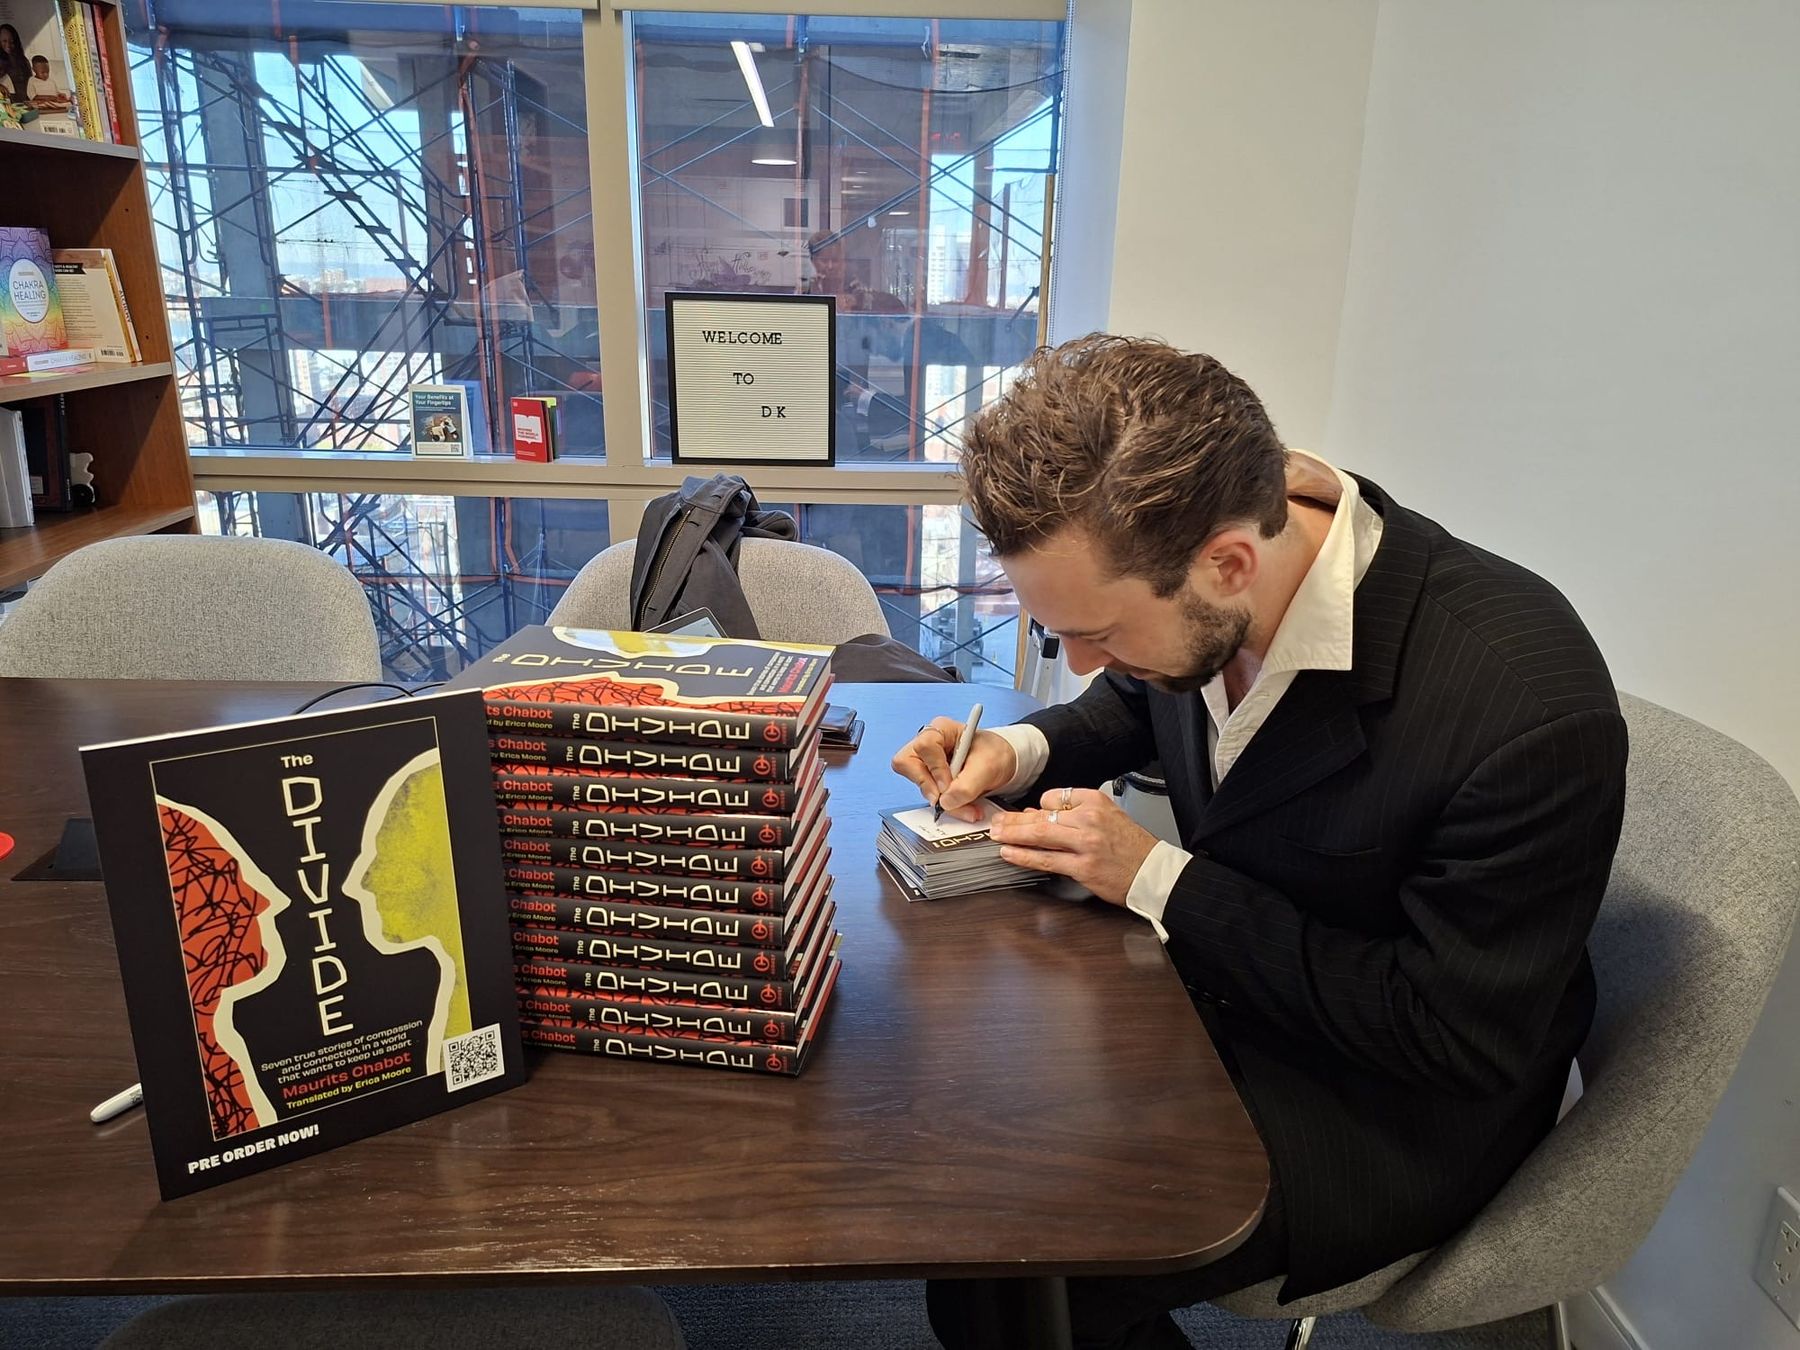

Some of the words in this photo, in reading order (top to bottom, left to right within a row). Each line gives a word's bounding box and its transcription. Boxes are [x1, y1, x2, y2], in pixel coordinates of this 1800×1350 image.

[13, 280, 44, 290] CHAKRA
[13, 290, 46, 301] HEALING
[702, 330, 783, 345] WELCOME
[732, 372, 754, 385] TO
[492, 652, 510, 664] The
[510, 654, 754, 678] DIVIDE
[503, 706, 553, 719] Chabot
[505, 720, 526, 728] Erica
[586, 712, 751, 740] DIVIDE
[498, 738, 547, 751] Chabot
[280, 752, 314, 770] The
[579, 745, 741, 772] DIVIDE
[503, 780, 553, 792] Chabot
[586, 784, 749, 807] DIVIDE
[504, 815, 552, 826] Chabot
[585, 819, 746, 842] DIVIDE
[504, 840, 551, 852] Chabot
[582, 846, 738, 873] DIVIDE
[509, 869, 555, 881] Chabot
[585, 875, 739, 904] DIVIDE
[280, 775, 354, 1037] DIVIDE
[511, 899, 557, 912] Chabot
[586, 907, 739, 936] DIVIDE
[514, 932, 559, 945] Chabot
[589, 939, 741, 969] DIVIDE
[522, 964, 567, 977] Chabot
[596, 972, 748, 1001] DIVIDE
[526, 1000, 571, 1013] Chabot
[601, 1007, 751, 1035] DIVIDE
[261, 1057, 292, 1072] Seven
[294, 1050, 316, 1062] true
[318, 1040, 352, 1056] stories
[354, 1036, 365, 1045] of
[366, 1019, 423, 1042] compassion
[531, 1030, 576, 1043] Chabot
[278, 1072, 300, 1085] that
[302, 1062, 334, 1078] wants
[335, 1059, 347, 1068] to
[348, 1052, 371, 1067] keep
[372, 1047, 384, 1057] us
[386, 1038, 412, 1055] apart
[281, 1062, 301, 1074] and
[302, 1048, 361, 1069] connection,
[362, 1042, 371, 1052] in
[373, 1041, 380, 1049] a
[381, 1032, 407, 1046] world
[605, 1038, 753, 1068] DIVIDE
[282, 1070, 349, 1099] Maurits
[351, 1052, 412, 1078] Chabot
[286, 1088, 340, 1110] Translated
[341, 1083, 354, 1094] by
[355, 1075, 380, 1089] Erica
[381, 1066, 412, 1082] Moore
[187, 1150, 221, 1175] PRE
[222, 1134, 277, 1164] ORDER
[278, 1123, 320, 1150] NOW!
